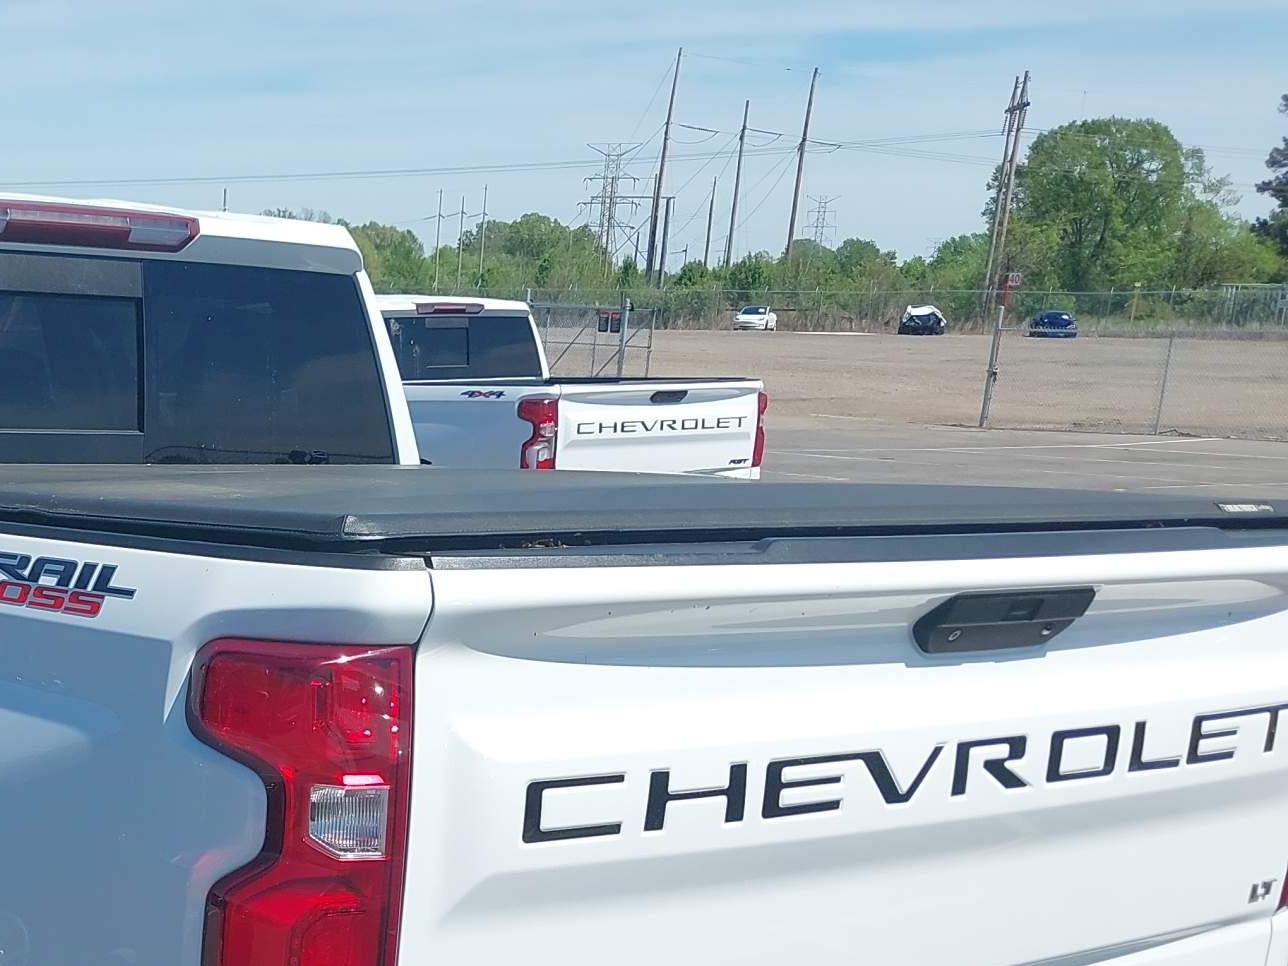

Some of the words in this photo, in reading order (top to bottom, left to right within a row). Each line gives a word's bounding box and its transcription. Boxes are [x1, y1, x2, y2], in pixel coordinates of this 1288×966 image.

[577, 416, 748, 435] CHEVROLET
[522, 703, 1288, 844] CHEVROLET
[1248, 879, 1278, 904] LT
